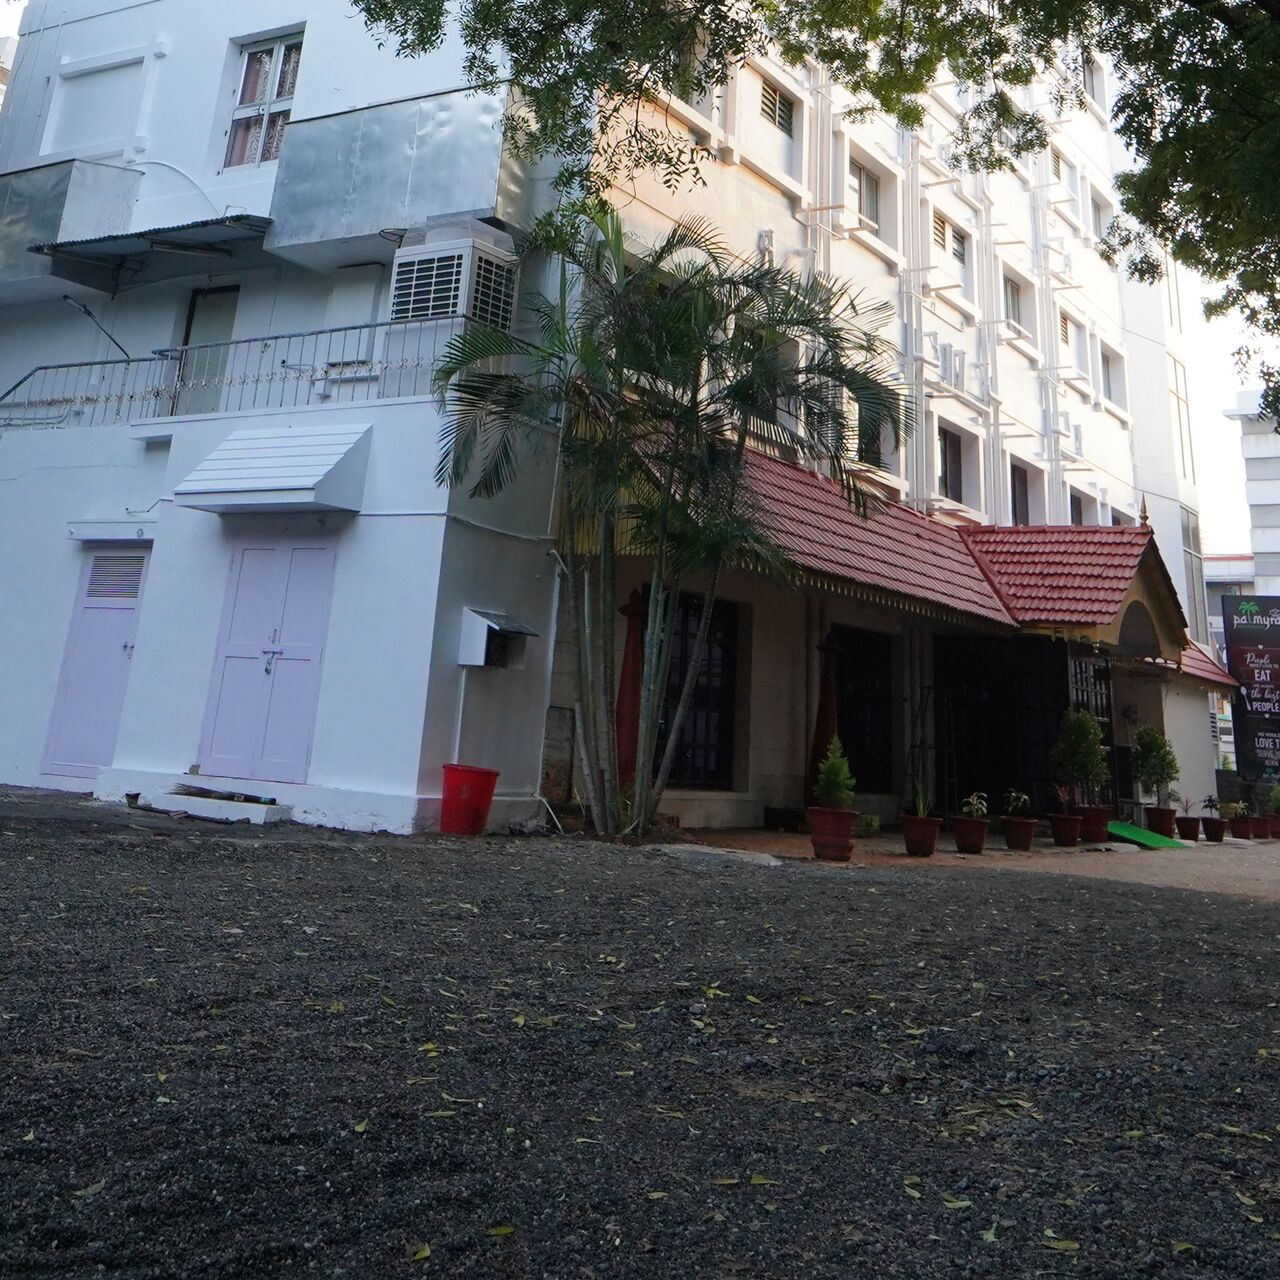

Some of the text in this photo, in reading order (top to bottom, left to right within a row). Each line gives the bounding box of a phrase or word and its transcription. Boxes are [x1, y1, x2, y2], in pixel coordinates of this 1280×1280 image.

[1254, 669, 1271, 682] EAT
[1252, 701, 1280, 713] PEOPLE
[1255, 737, 1274, 749] LOVE
